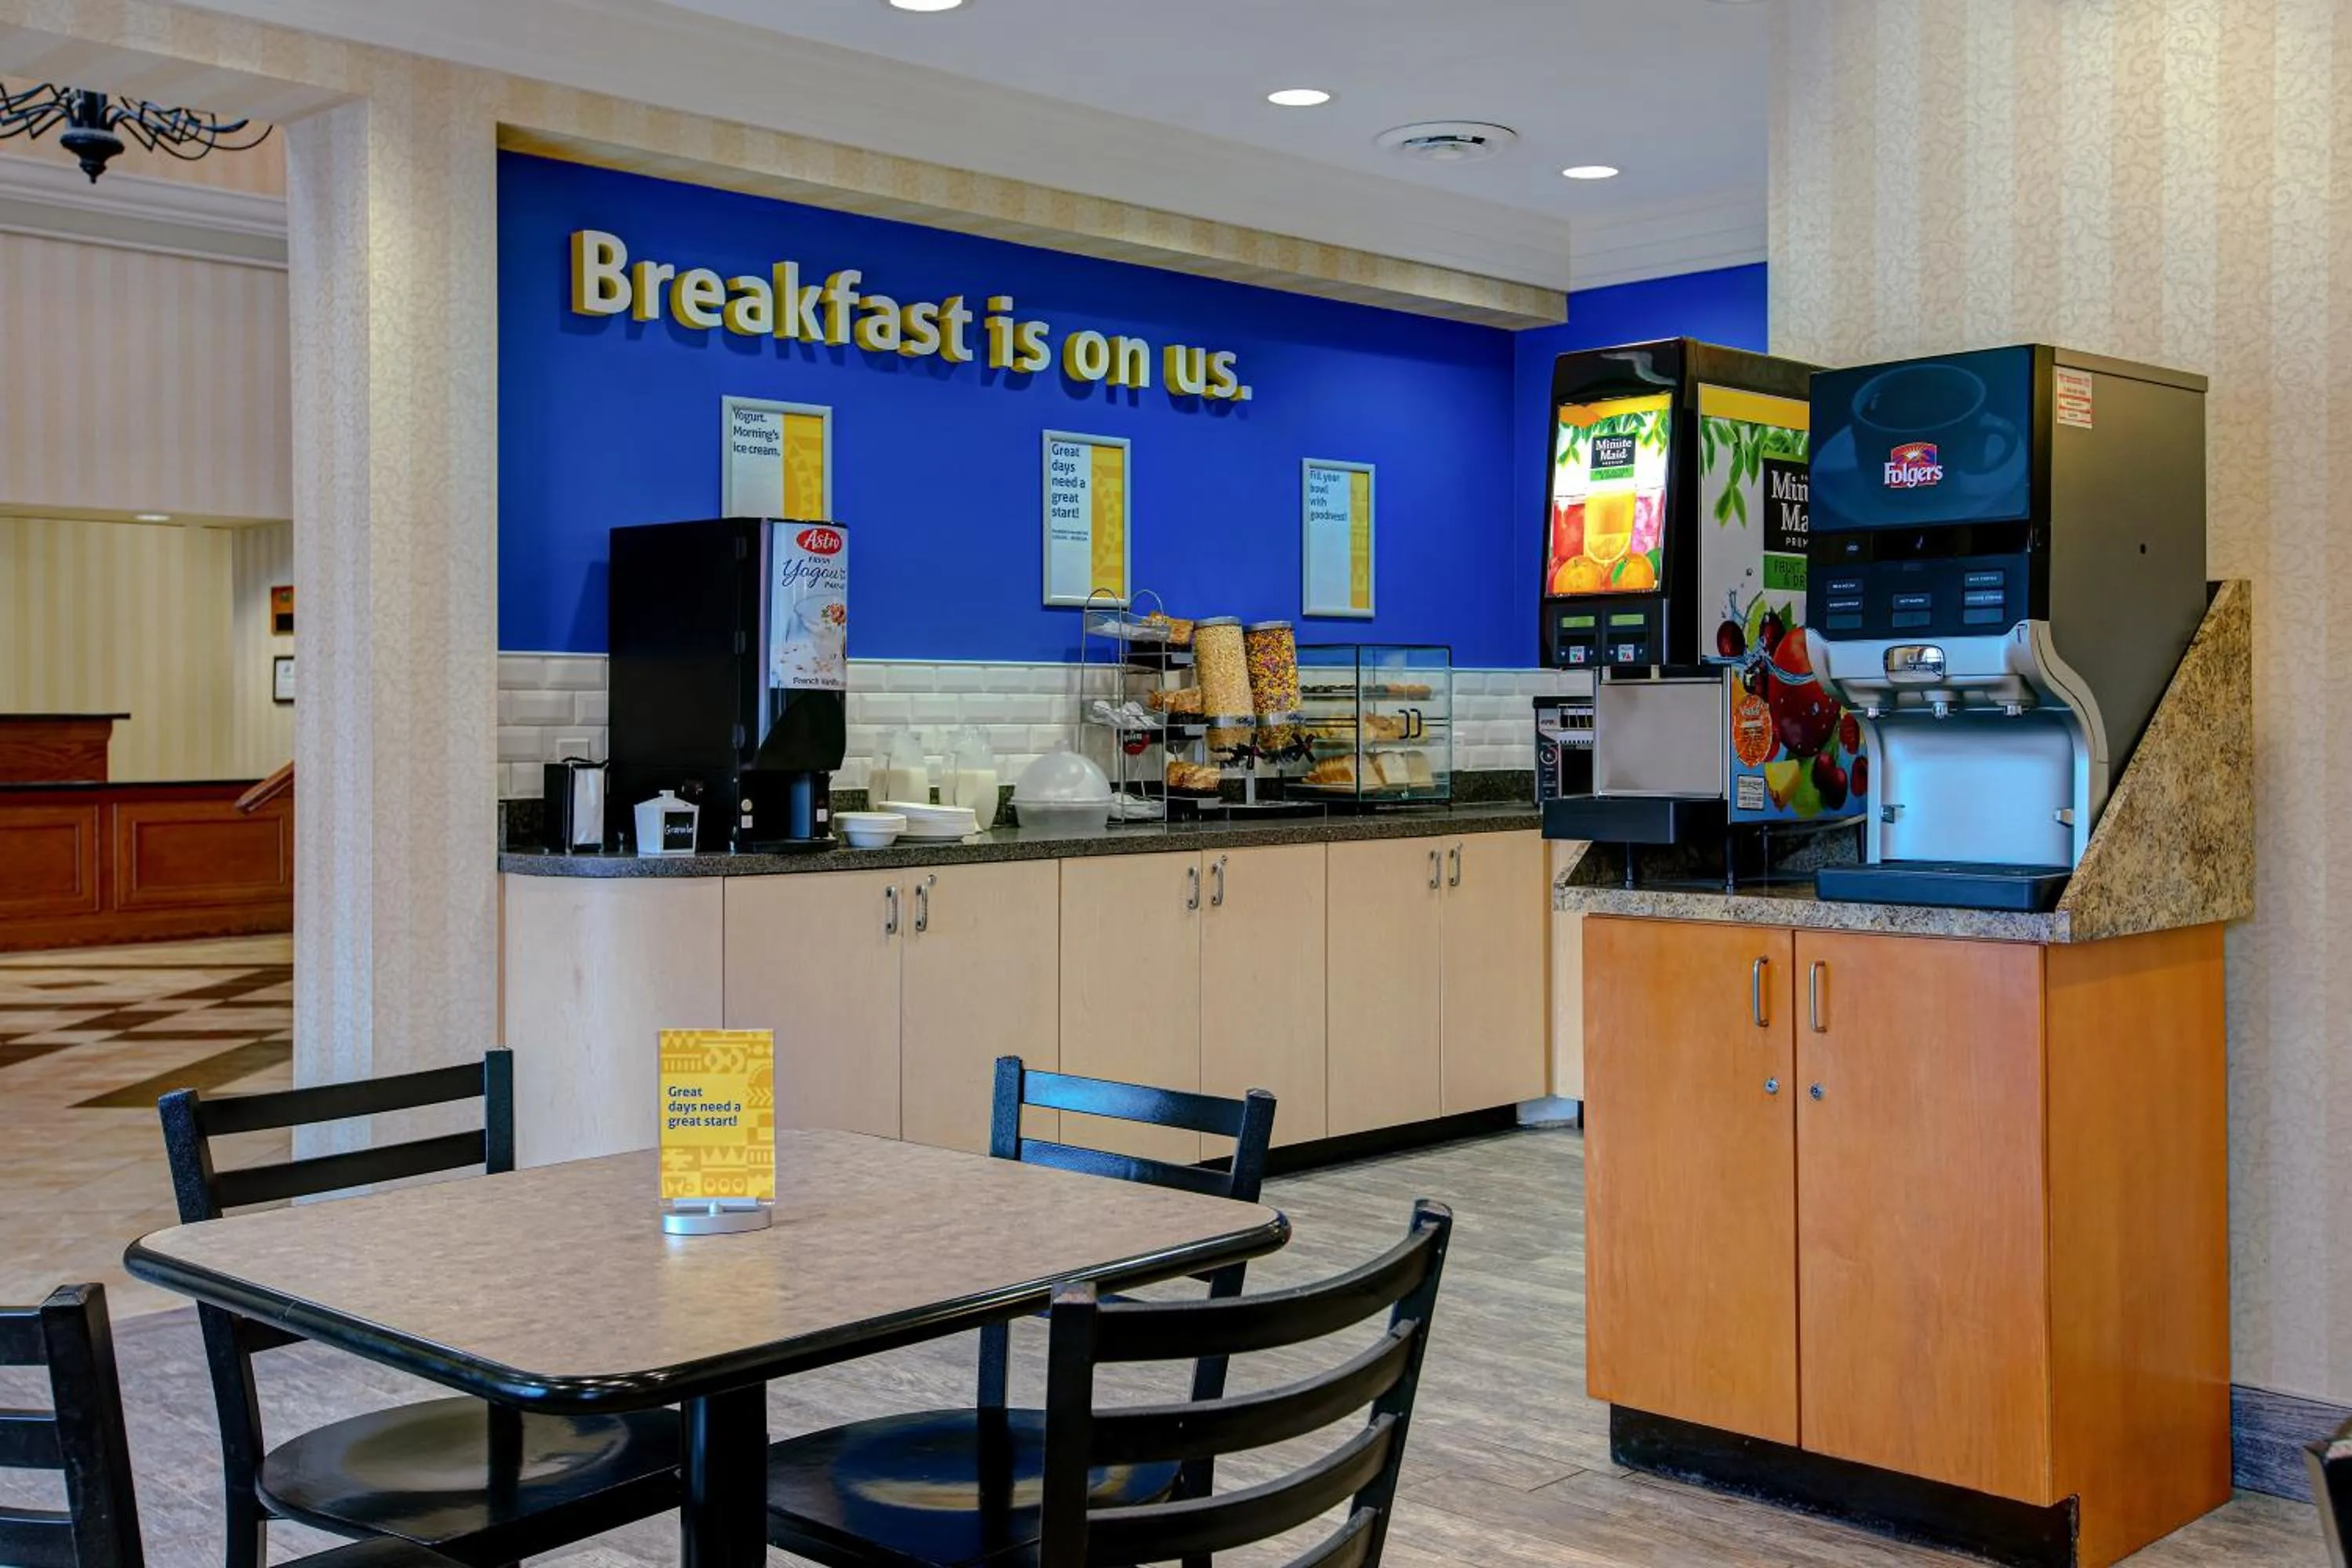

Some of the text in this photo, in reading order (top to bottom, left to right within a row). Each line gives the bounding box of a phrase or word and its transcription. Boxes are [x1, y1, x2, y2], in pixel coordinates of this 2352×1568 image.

[571, 230, 1253, 401] Breakfast is on us.
[733, 426, 780, 443] Morning's
[1051, 443, 1080, 457] Great
[1595, 438, 1632, 451] Minute
[1600, 448, 1628, 461] Maid
[1051, 459, 1076, 475] days
[1051, 476, 1086, 488] need a
[1883, 462, 1944, 488] Folgers
[1051, 492, 1080, 506] great
[1051, 506, 1080, 518] start!
[804, 529, 840, 550] Astro
[669, 1086, 702, 1097] Great
[668, 1100, 741, 1115] days need a
[668, 1115, 738, 1129] great start!
